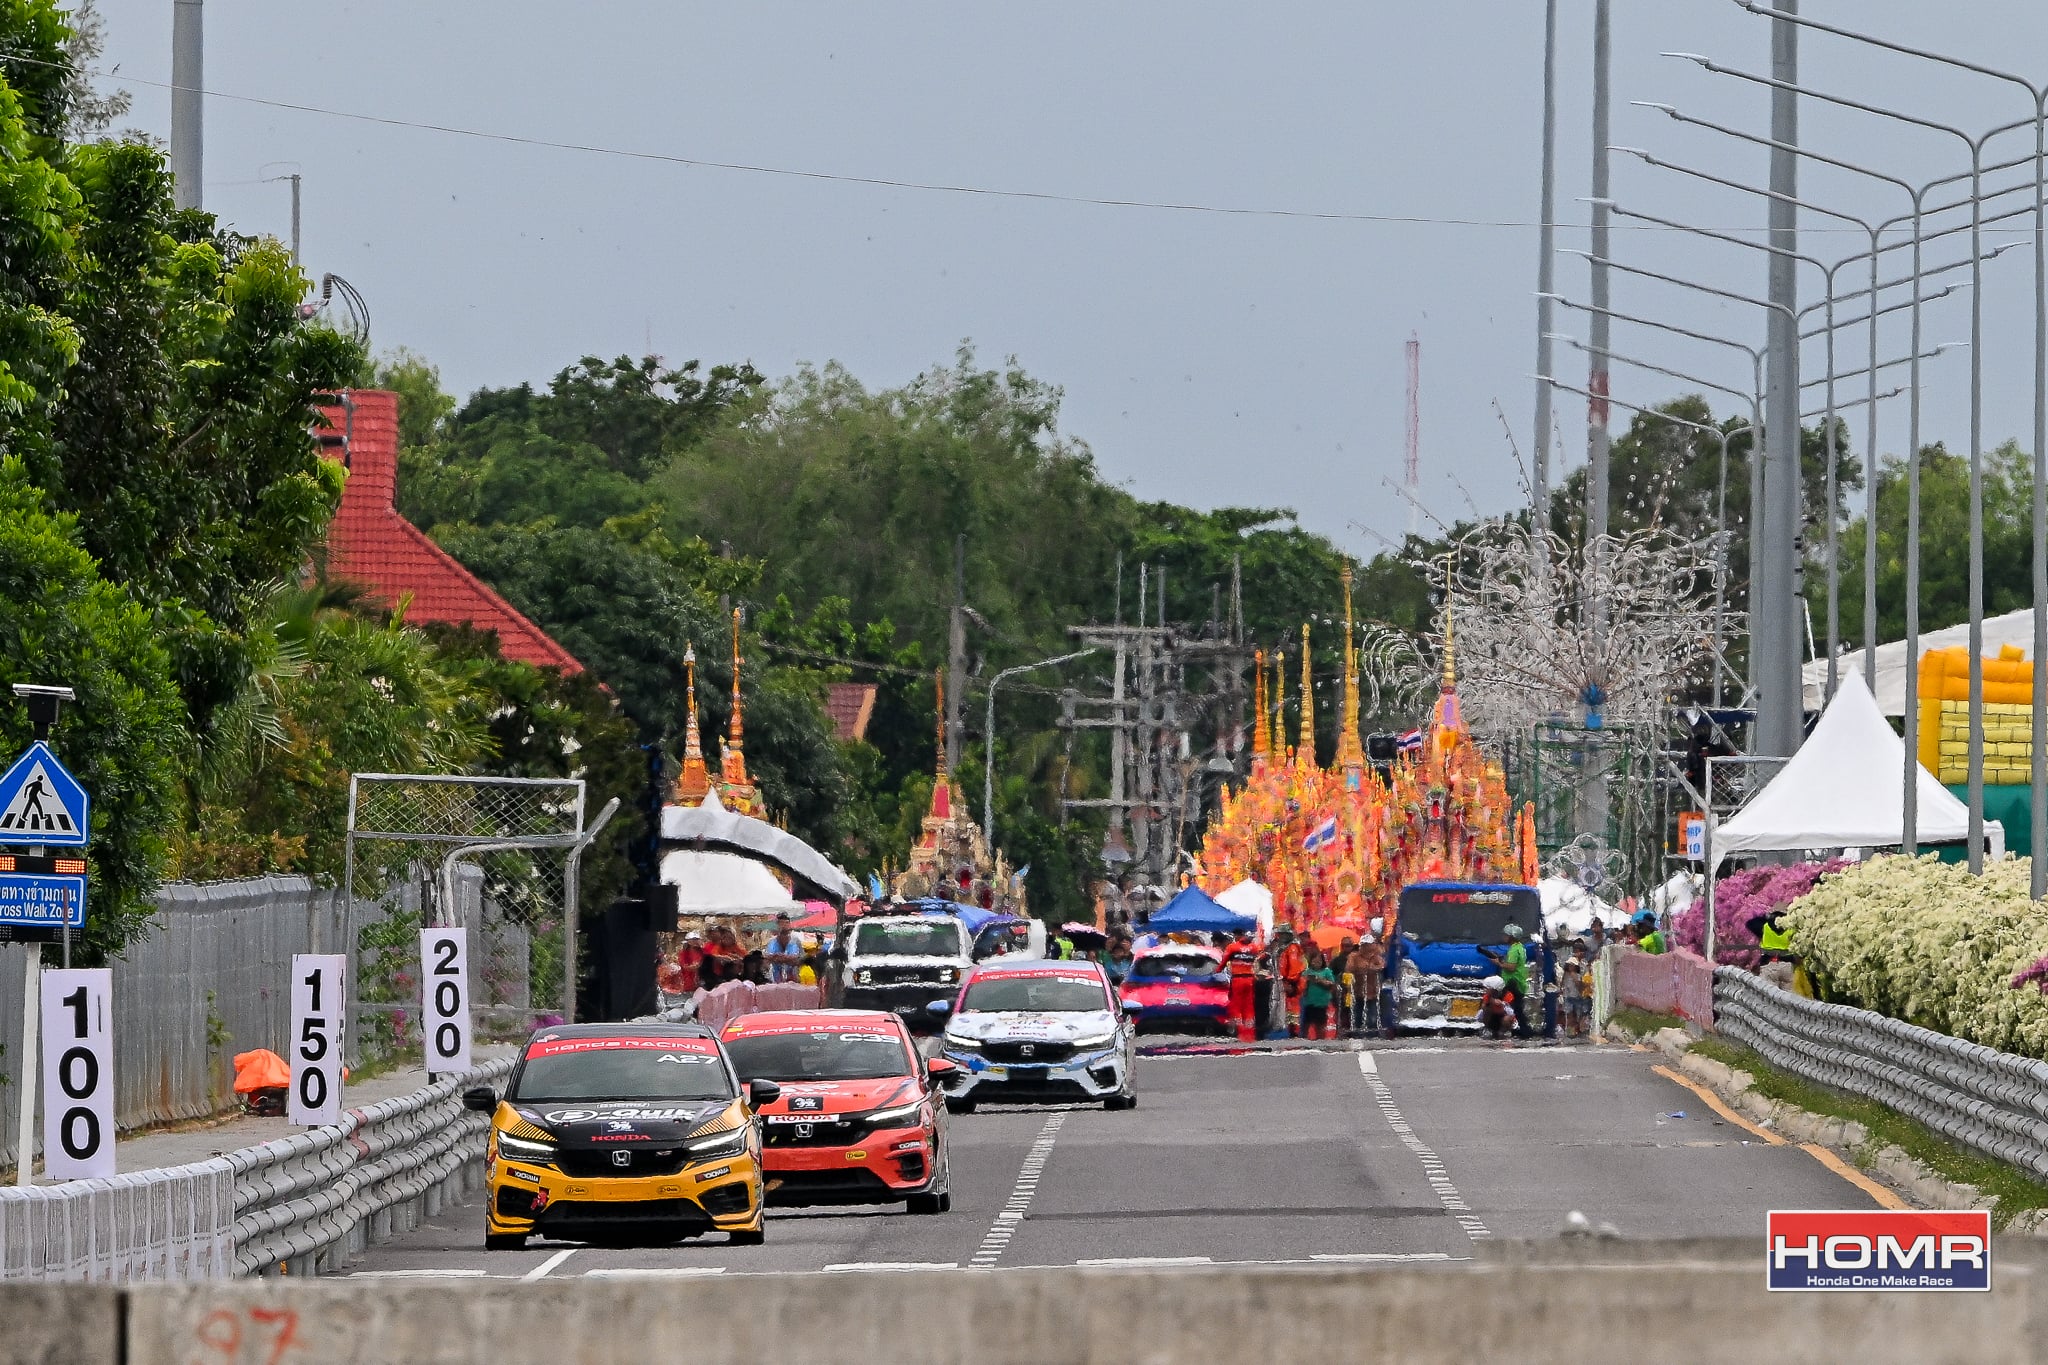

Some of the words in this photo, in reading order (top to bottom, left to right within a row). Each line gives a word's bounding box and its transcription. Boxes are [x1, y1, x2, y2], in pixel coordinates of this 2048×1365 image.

[0, 904, 22, 917] ross
[24, 902, 48, 918] Walk
[49, 904, 74, 919] Zoe
[432, 940, 462, 1059] 200
[810, 1025, 886, 1033] RACING
[299, 968, 328, 1110] 150
[625, 1040, 707, 1051] RACING
[656, 1054, 718, 1064] A27
[58, 985, 101, 1161] 100
[591, 1134, 652, 1142] HONDA
